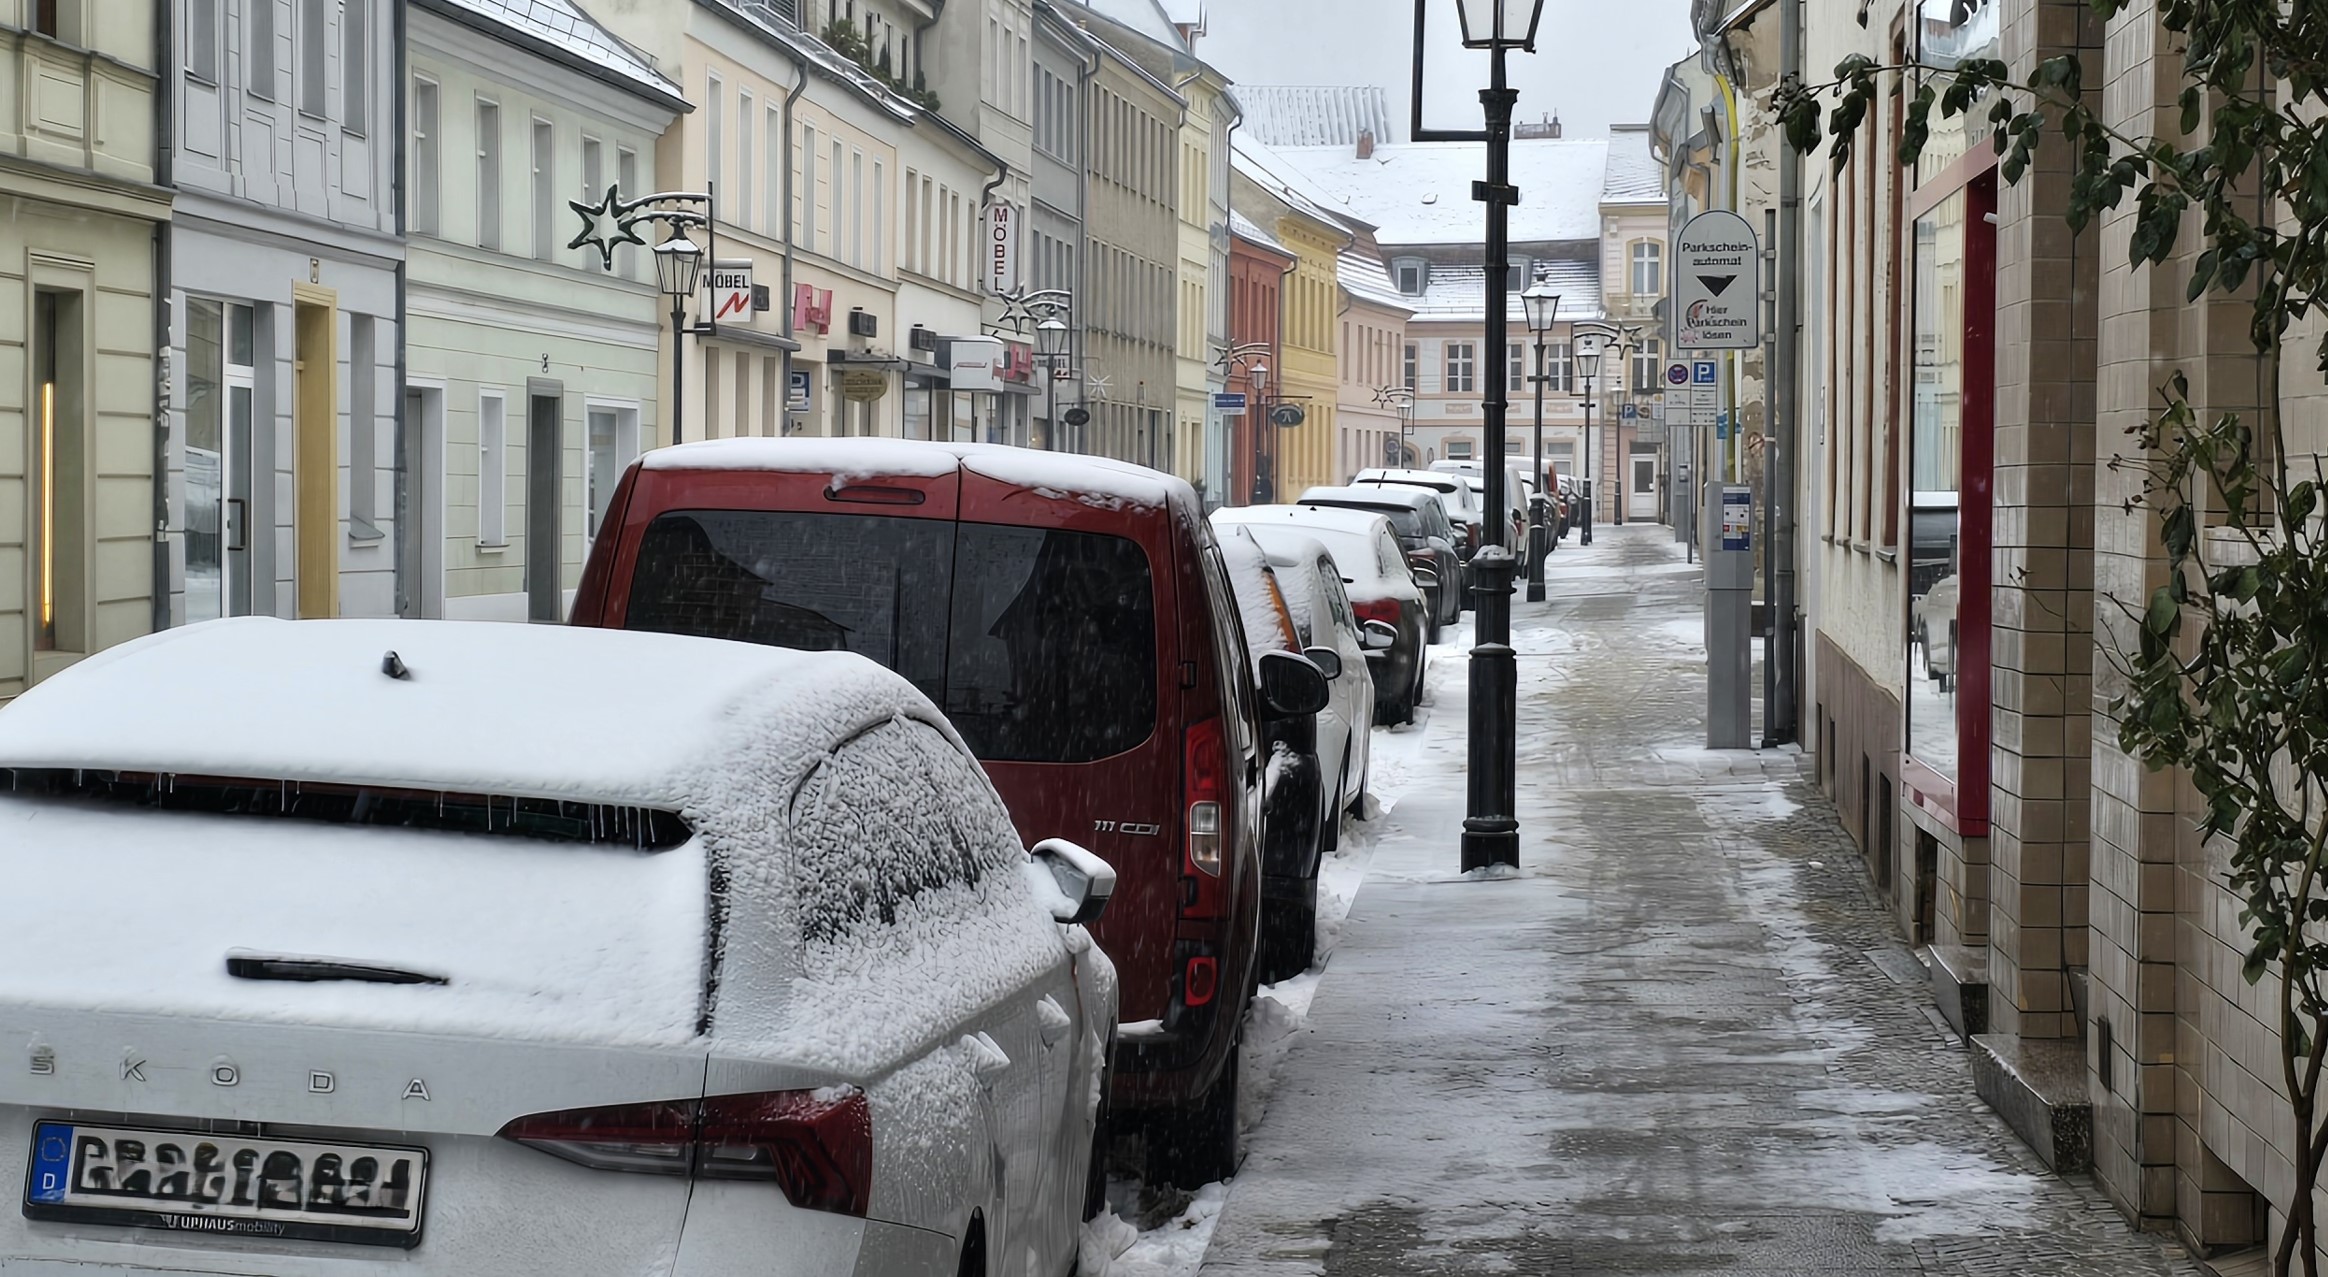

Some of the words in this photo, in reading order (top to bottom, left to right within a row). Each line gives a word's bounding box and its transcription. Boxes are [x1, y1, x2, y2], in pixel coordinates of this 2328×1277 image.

[993, 207, 1008, 292] MÖBEL
[1682, 242, 1753, 253] Parkschein-
[1692, 256, 1742, 266] automat
[702, 270, 750, 289] MÖBEL
[1706, 305, 1728, 314] Hier
[1702, 330, 1732, 339] lösen
[1119, 822, 1160, 836] CDI
[42, 1172, 55, 1190] D
